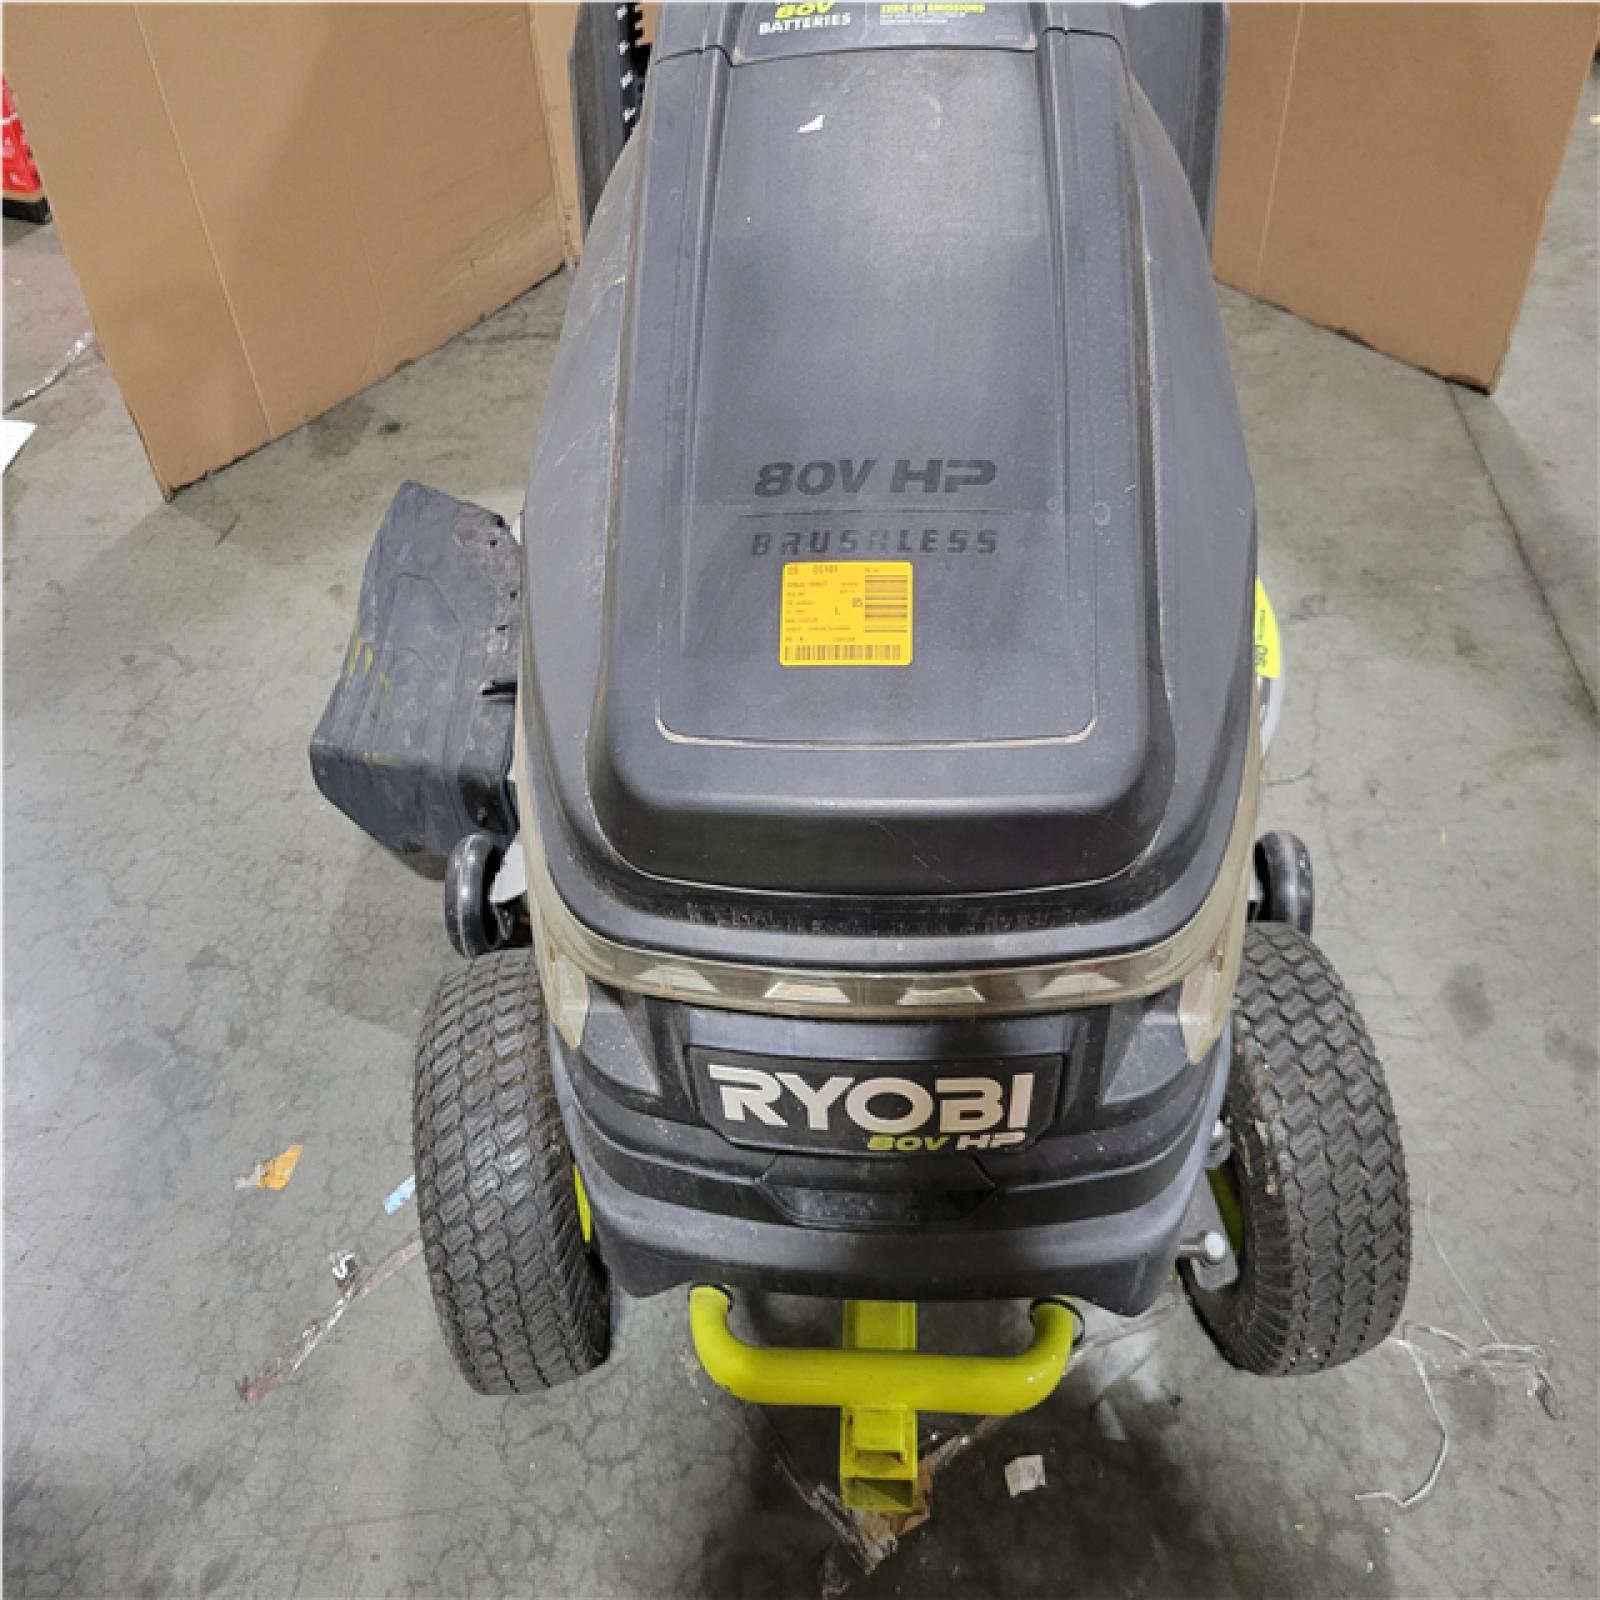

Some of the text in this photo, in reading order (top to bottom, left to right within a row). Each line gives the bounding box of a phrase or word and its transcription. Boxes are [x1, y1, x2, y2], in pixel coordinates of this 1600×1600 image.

[760, 12, 851, 35] BATTERIES
[754, 459, 997, 497] 80V HP
[752, 529, 998, 556] BRUSHLESS
[709, 1064, 1034, 1134] RYOBI
[867, 1132, 1026, 1151] 80V HP
